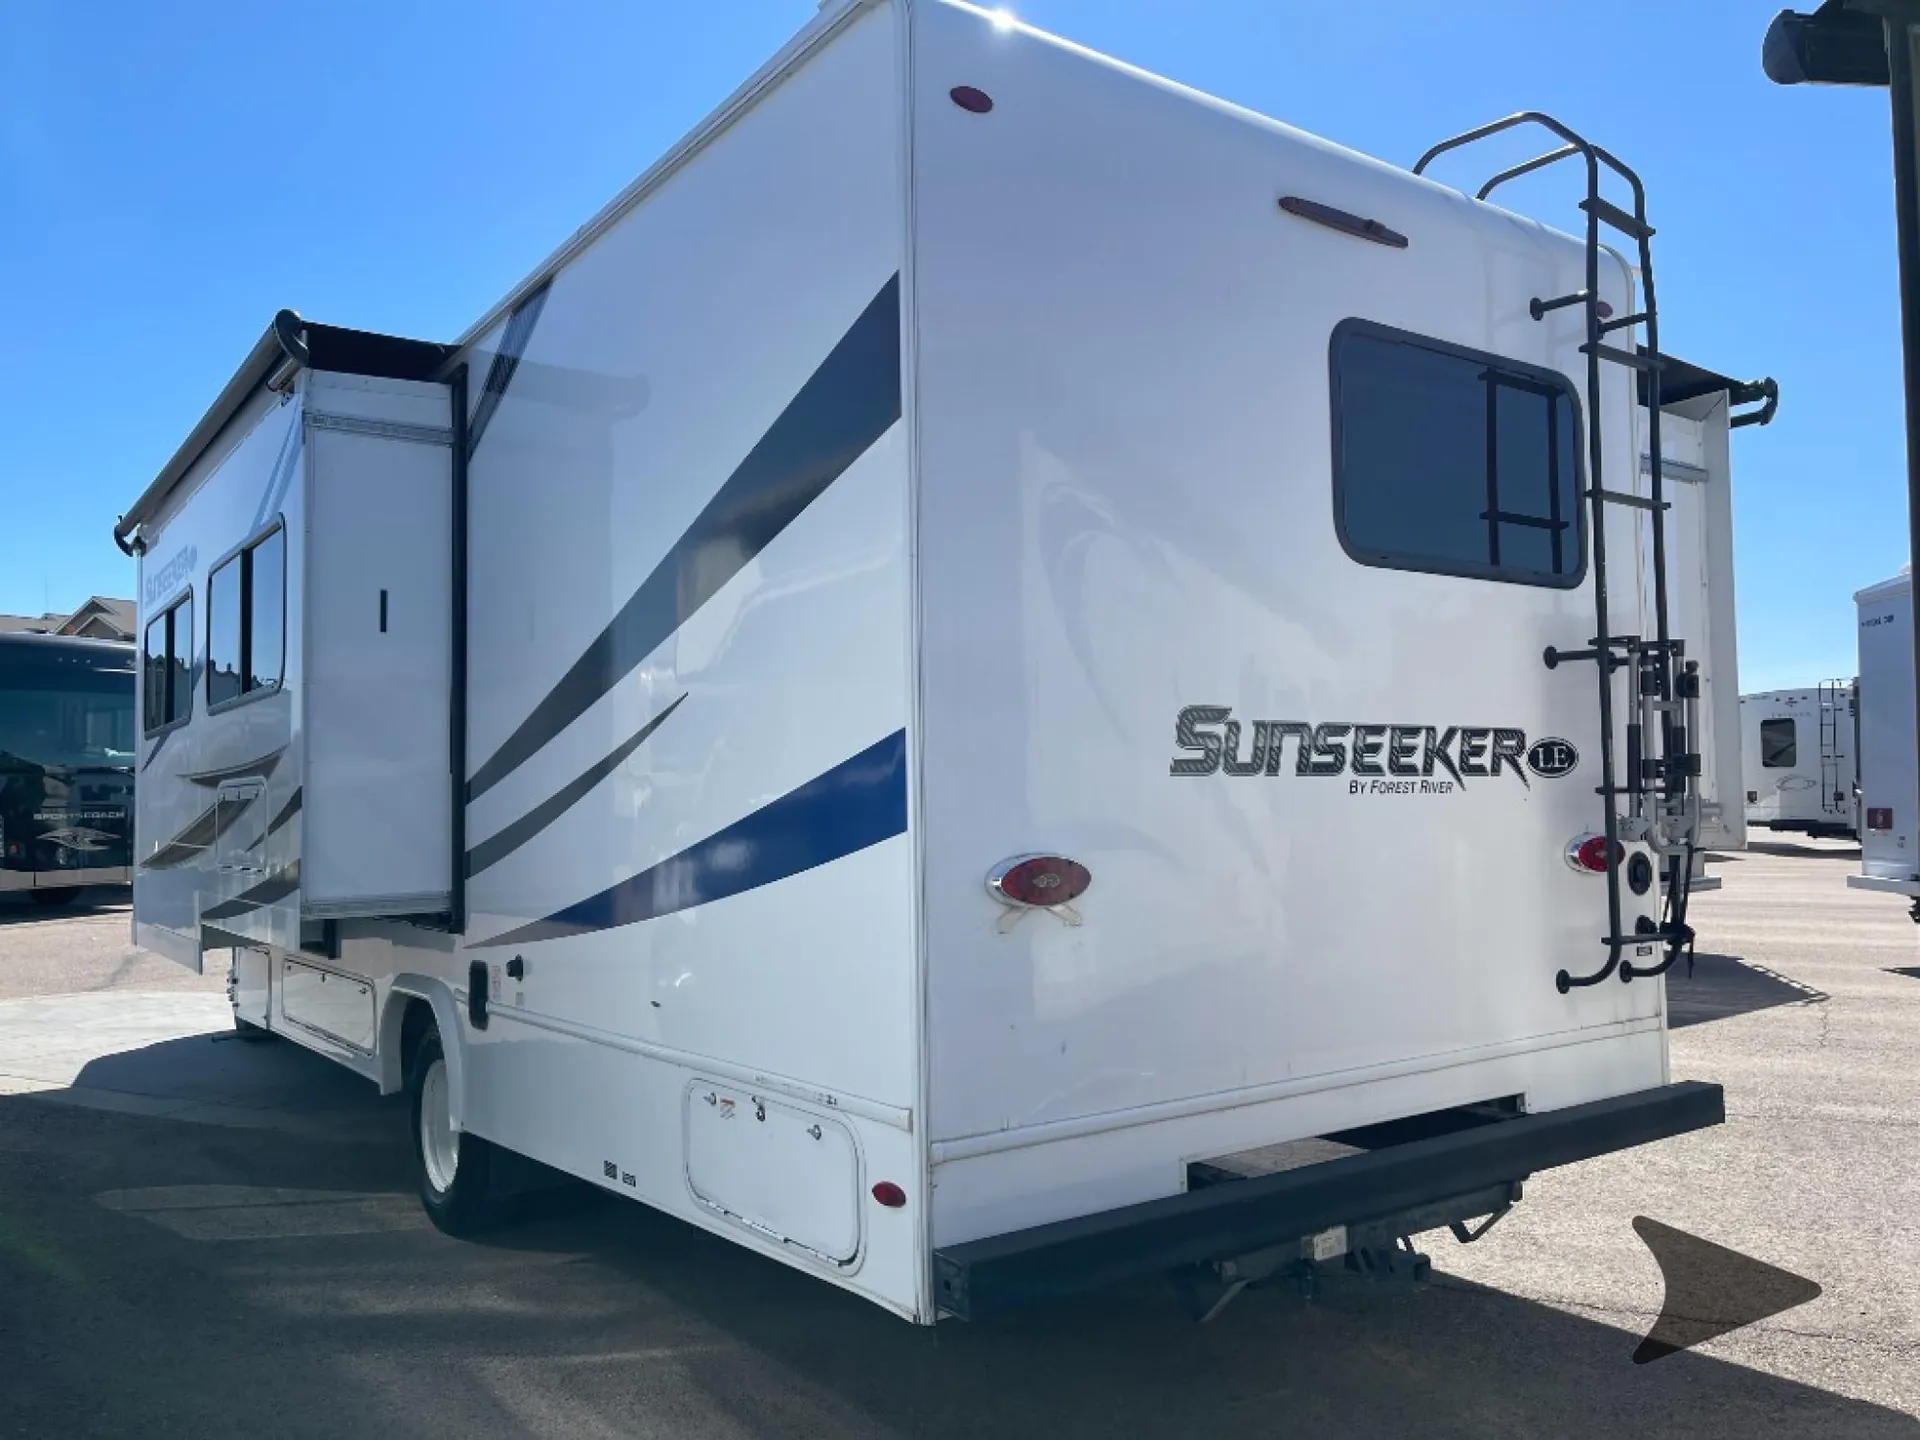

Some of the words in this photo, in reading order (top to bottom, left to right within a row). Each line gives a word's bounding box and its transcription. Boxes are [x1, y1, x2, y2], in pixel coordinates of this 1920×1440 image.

[1170, 704, 1530, 791] SUNSEEKER
[1535, 745, 1569, 768] LE
[1370, 780, 1416, 794] FOREST
[1420, 780, 1454, 794] RIVER
